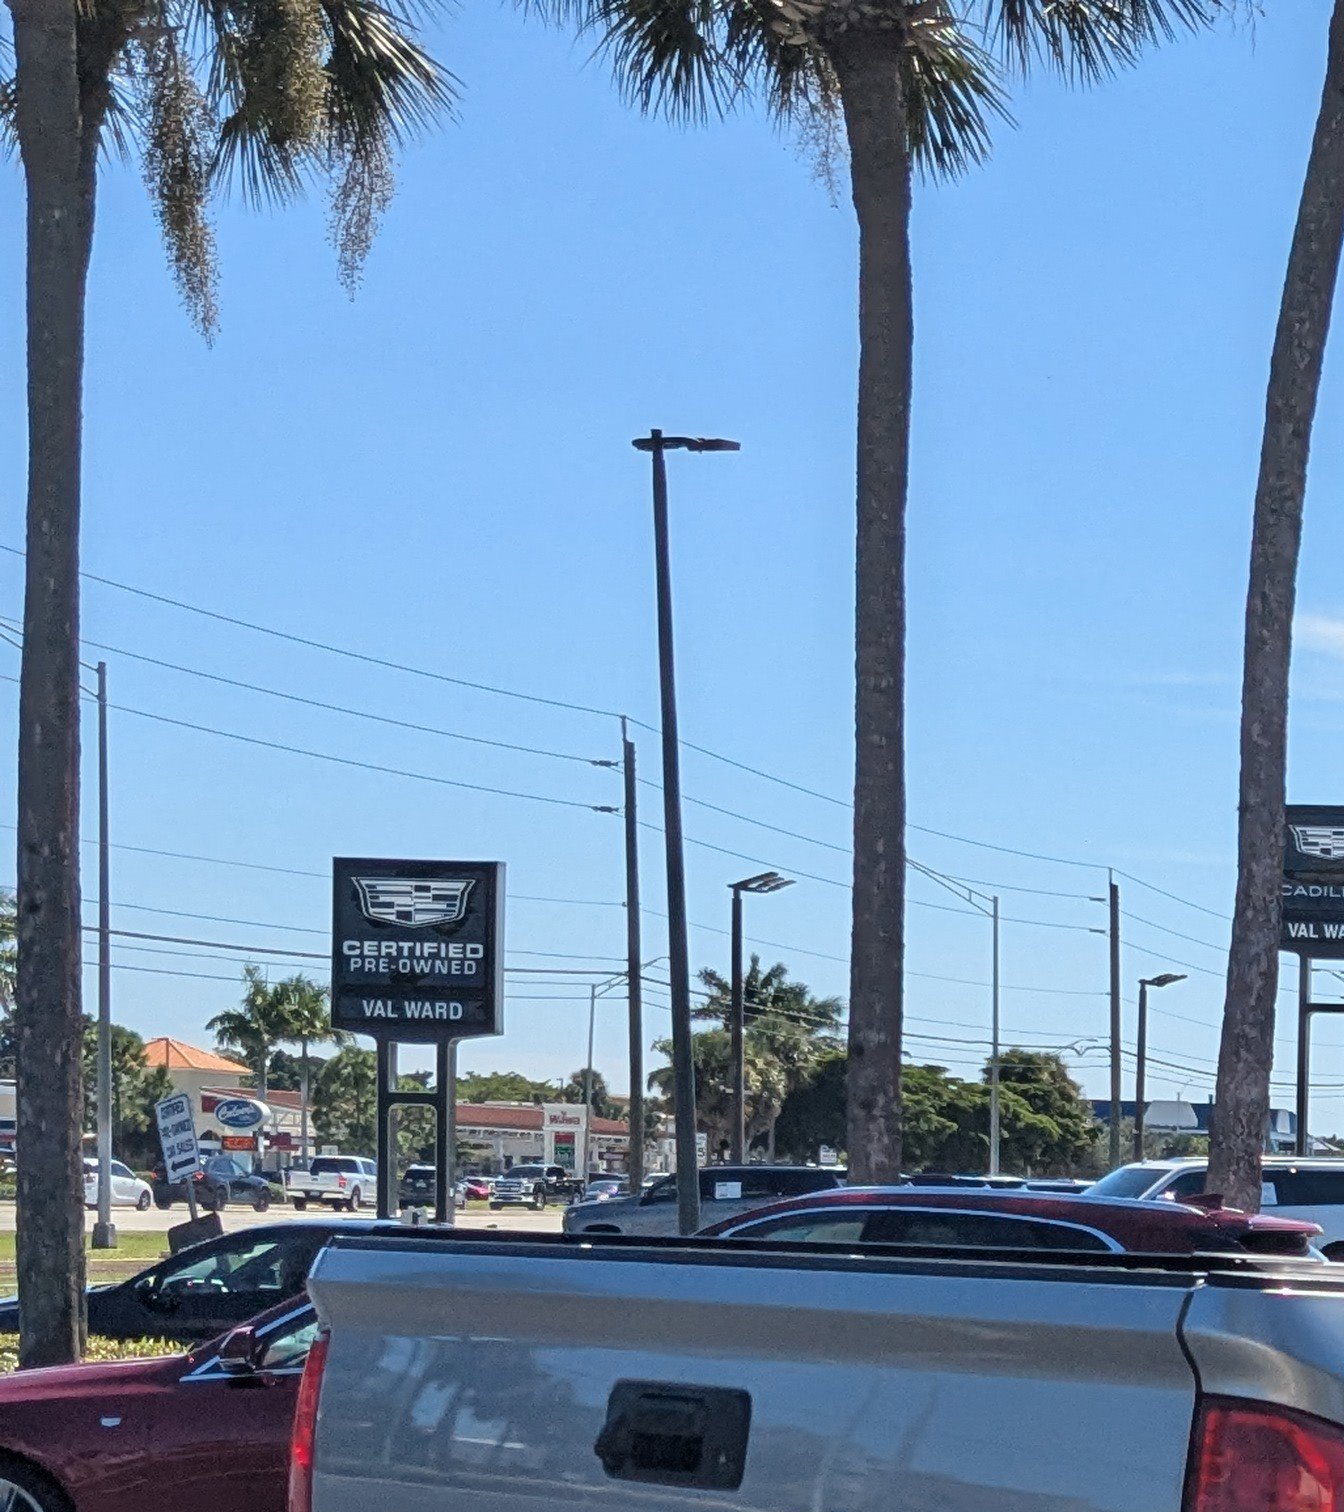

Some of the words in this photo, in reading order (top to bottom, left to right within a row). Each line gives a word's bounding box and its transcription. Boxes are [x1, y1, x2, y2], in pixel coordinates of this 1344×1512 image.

[1288, 923, 1319, 938] VAL
[342, 940, 484, 959] CERTIFIED
[350, 957, 477, 975] PRE-OWNED
[362, 999, 399, 1018] VAL
[404, 1001, 463, 1020] WARD
